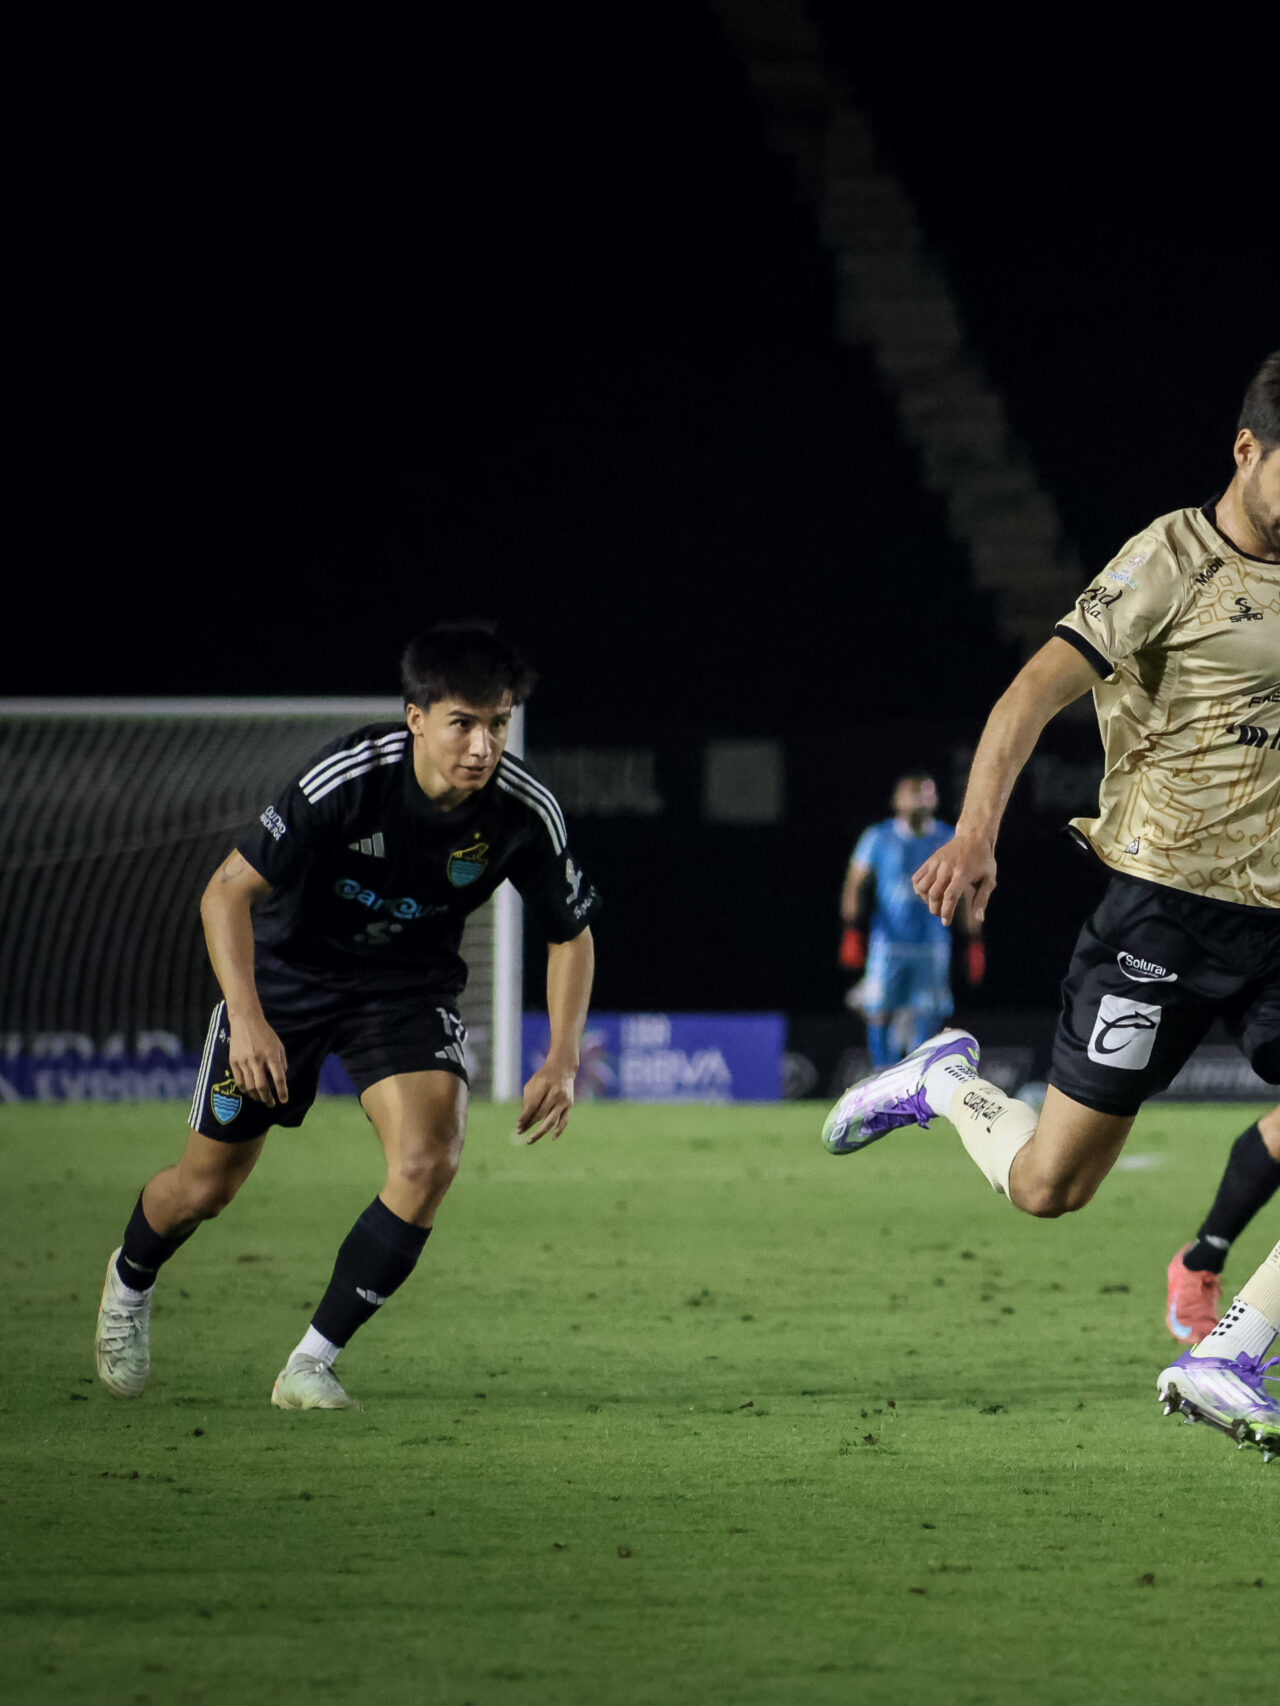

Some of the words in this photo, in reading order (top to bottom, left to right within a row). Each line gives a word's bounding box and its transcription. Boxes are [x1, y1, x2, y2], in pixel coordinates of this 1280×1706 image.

[1195, 556, 1225, 586] Mobil
[1083, 585, 1123, 611] Rd
[1230, 612, 1264, 623] SPIRO
